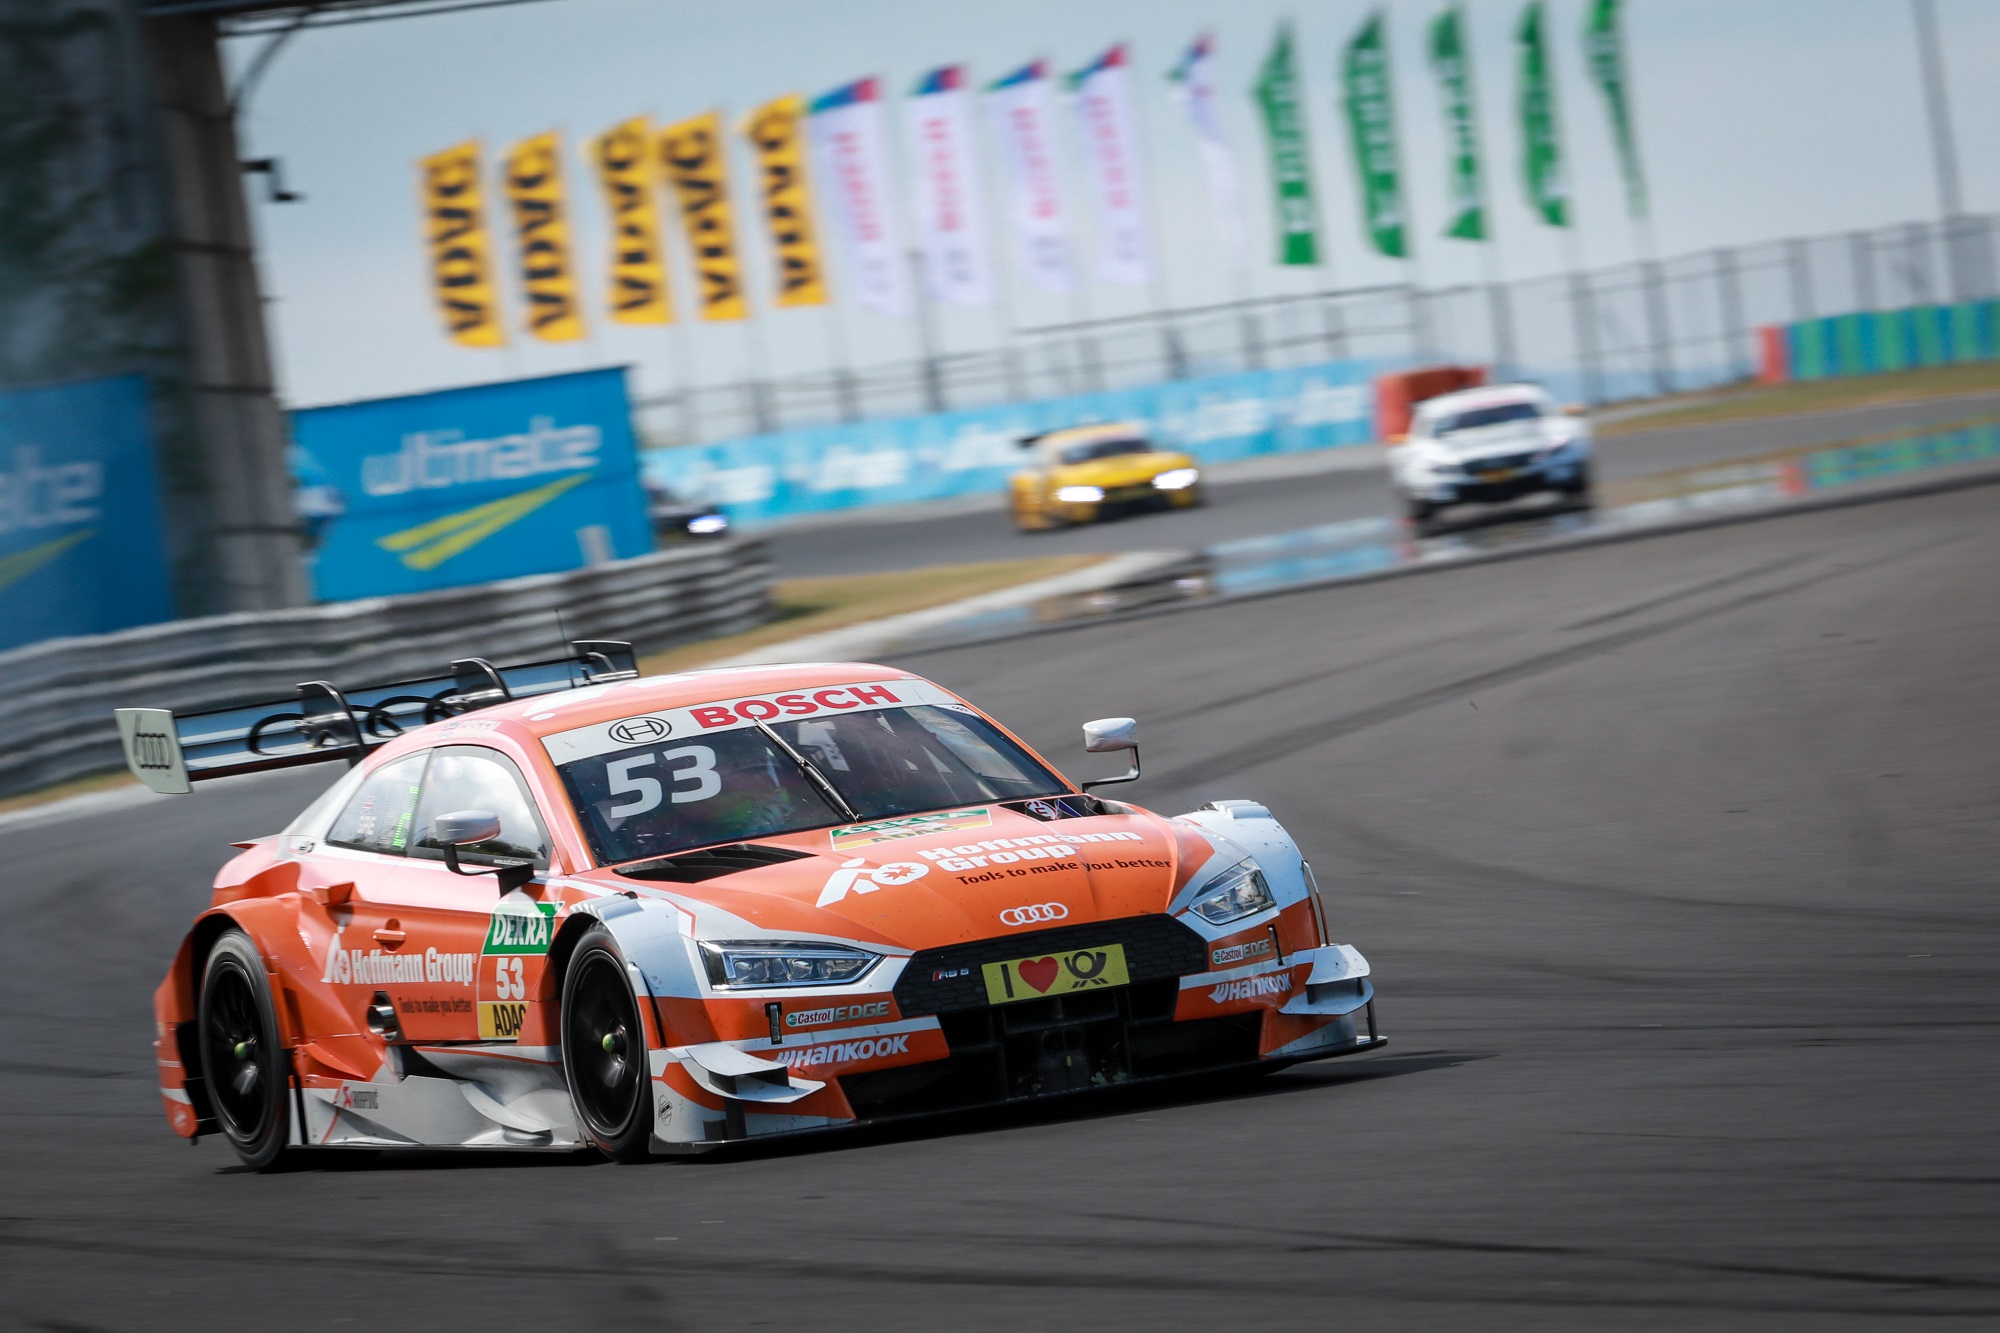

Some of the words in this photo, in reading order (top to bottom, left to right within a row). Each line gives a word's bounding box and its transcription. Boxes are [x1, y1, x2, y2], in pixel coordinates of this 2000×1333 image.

[361, 414, 601, 496] ultimate
[688, 685, 902, 729] BOSCH
[606, 745, 722, 819] 53
[917, 831, 1143, 860] Hoffmann
[937, 844, 1077, 872] Group
[957, 871, 1004, 885] Tools
[1009, 867, 1027, 877] to
[1030, 860, 1078, 874] make
[1081, 860, 1113, 872] you
[1115, 858, 1171, 869] better
[492, 913, 547, 946] DEKRA
[1221, 946, 1242, 961] Castrol
[1243, 938, 1270, 958] EDGE
[351, 949, 425, 984] Hoffmann
[426, 947, 473, 986] Group
[496, 957, 525, 1000] 53
[797, 1009, 831, 1025] Castrol
[834, 1001, 890, 1021] EDGE
